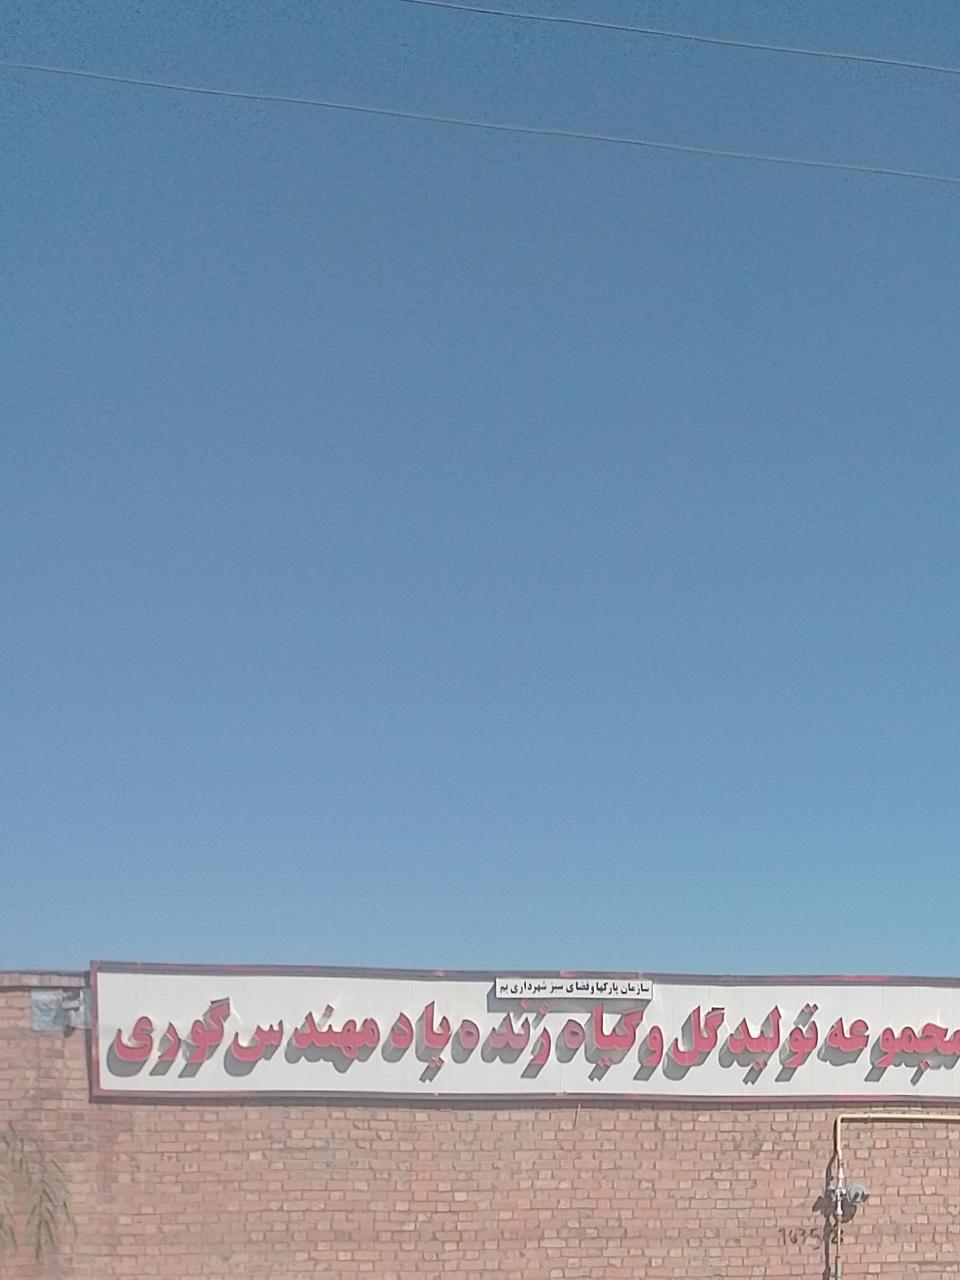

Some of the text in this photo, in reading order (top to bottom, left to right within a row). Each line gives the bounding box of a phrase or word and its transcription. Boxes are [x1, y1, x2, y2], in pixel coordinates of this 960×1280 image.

[510, 981, 547, 994] شهرداری
[620, 982, 649, 995] سازمان
[231, 1003, 381, 1062] مهندس
[643, 1021, 665, 1070] و
[671, 1005, 726, 1067] گل
[727, 1003, 819, 1069] تولید
